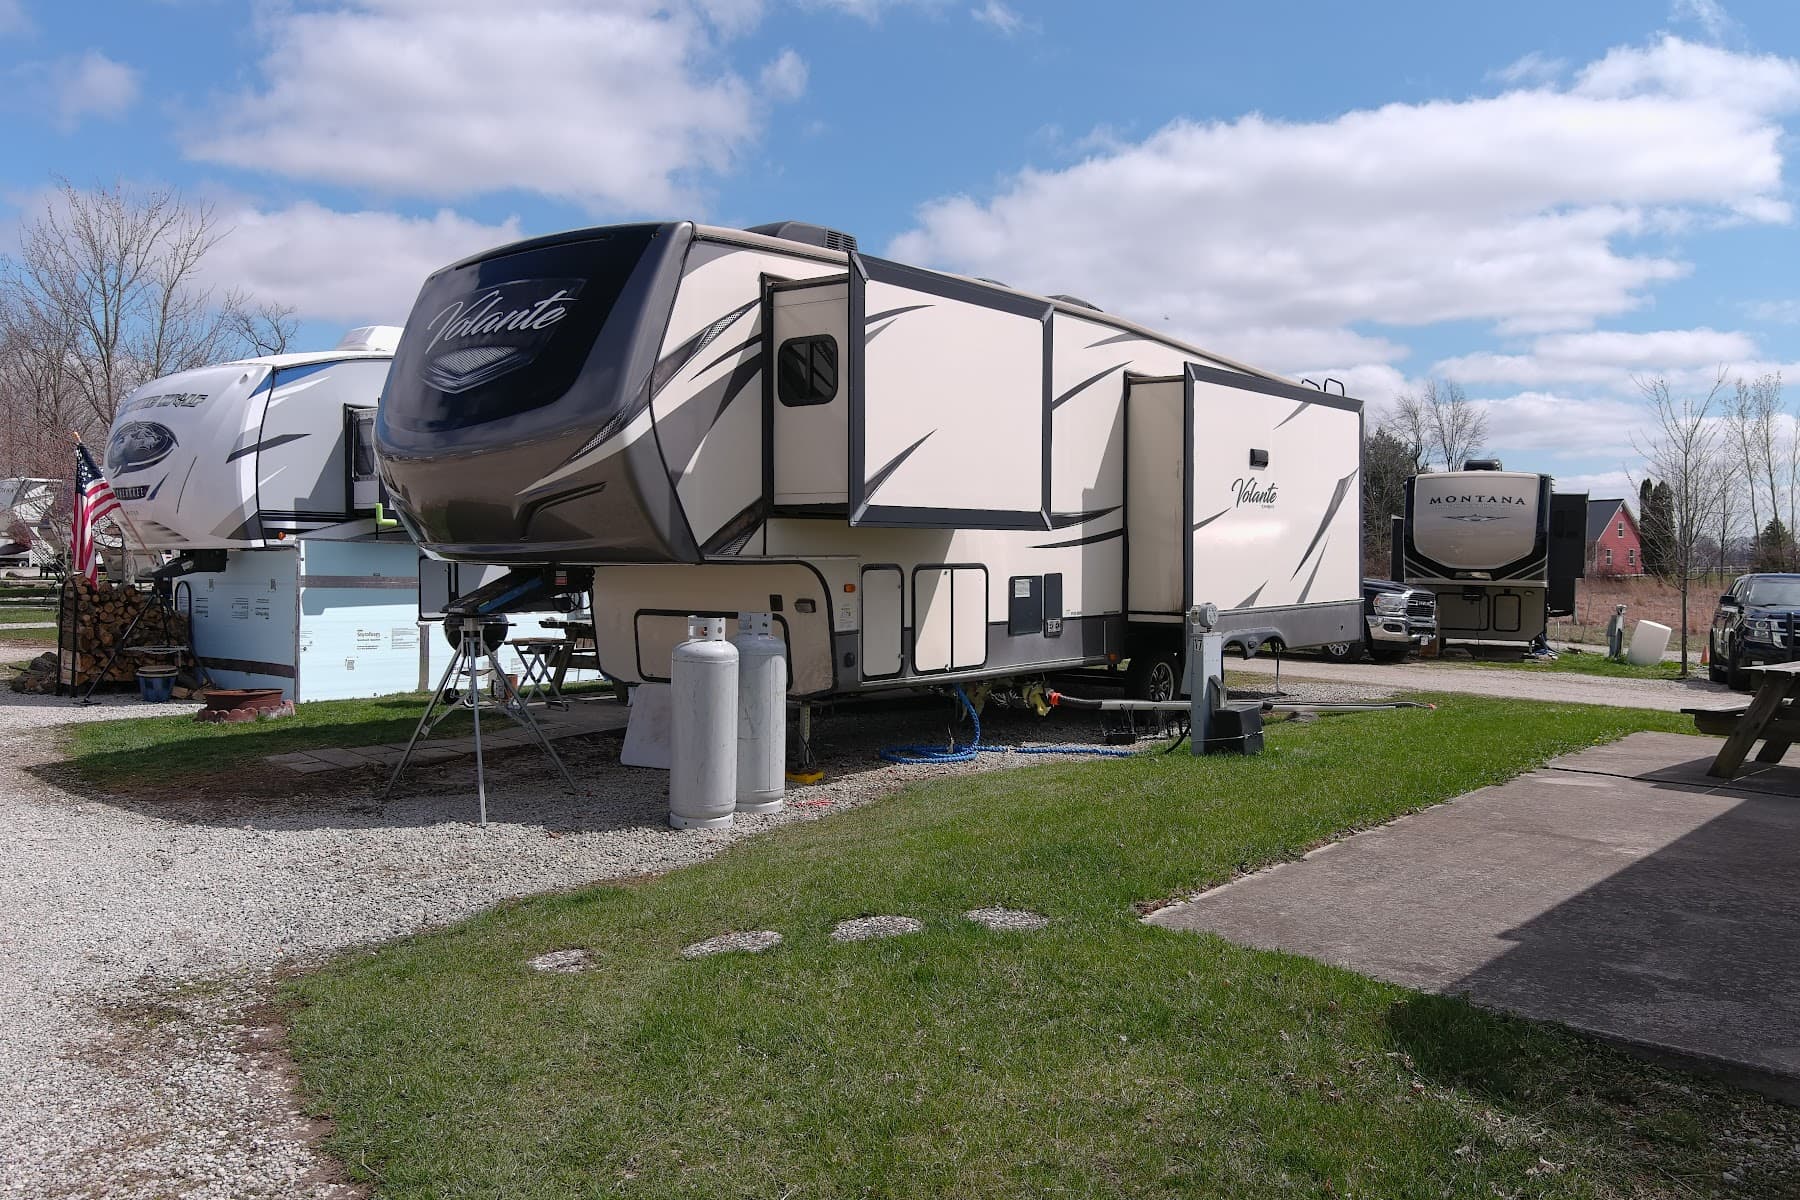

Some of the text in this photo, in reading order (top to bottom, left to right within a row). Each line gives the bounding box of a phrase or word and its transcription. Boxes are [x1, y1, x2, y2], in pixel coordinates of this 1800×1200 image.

[425, 289, 580, 355] Volante
[1231, 477, 1279, 509] Volante
[1429, 495, 1526, 505] MONTANA
